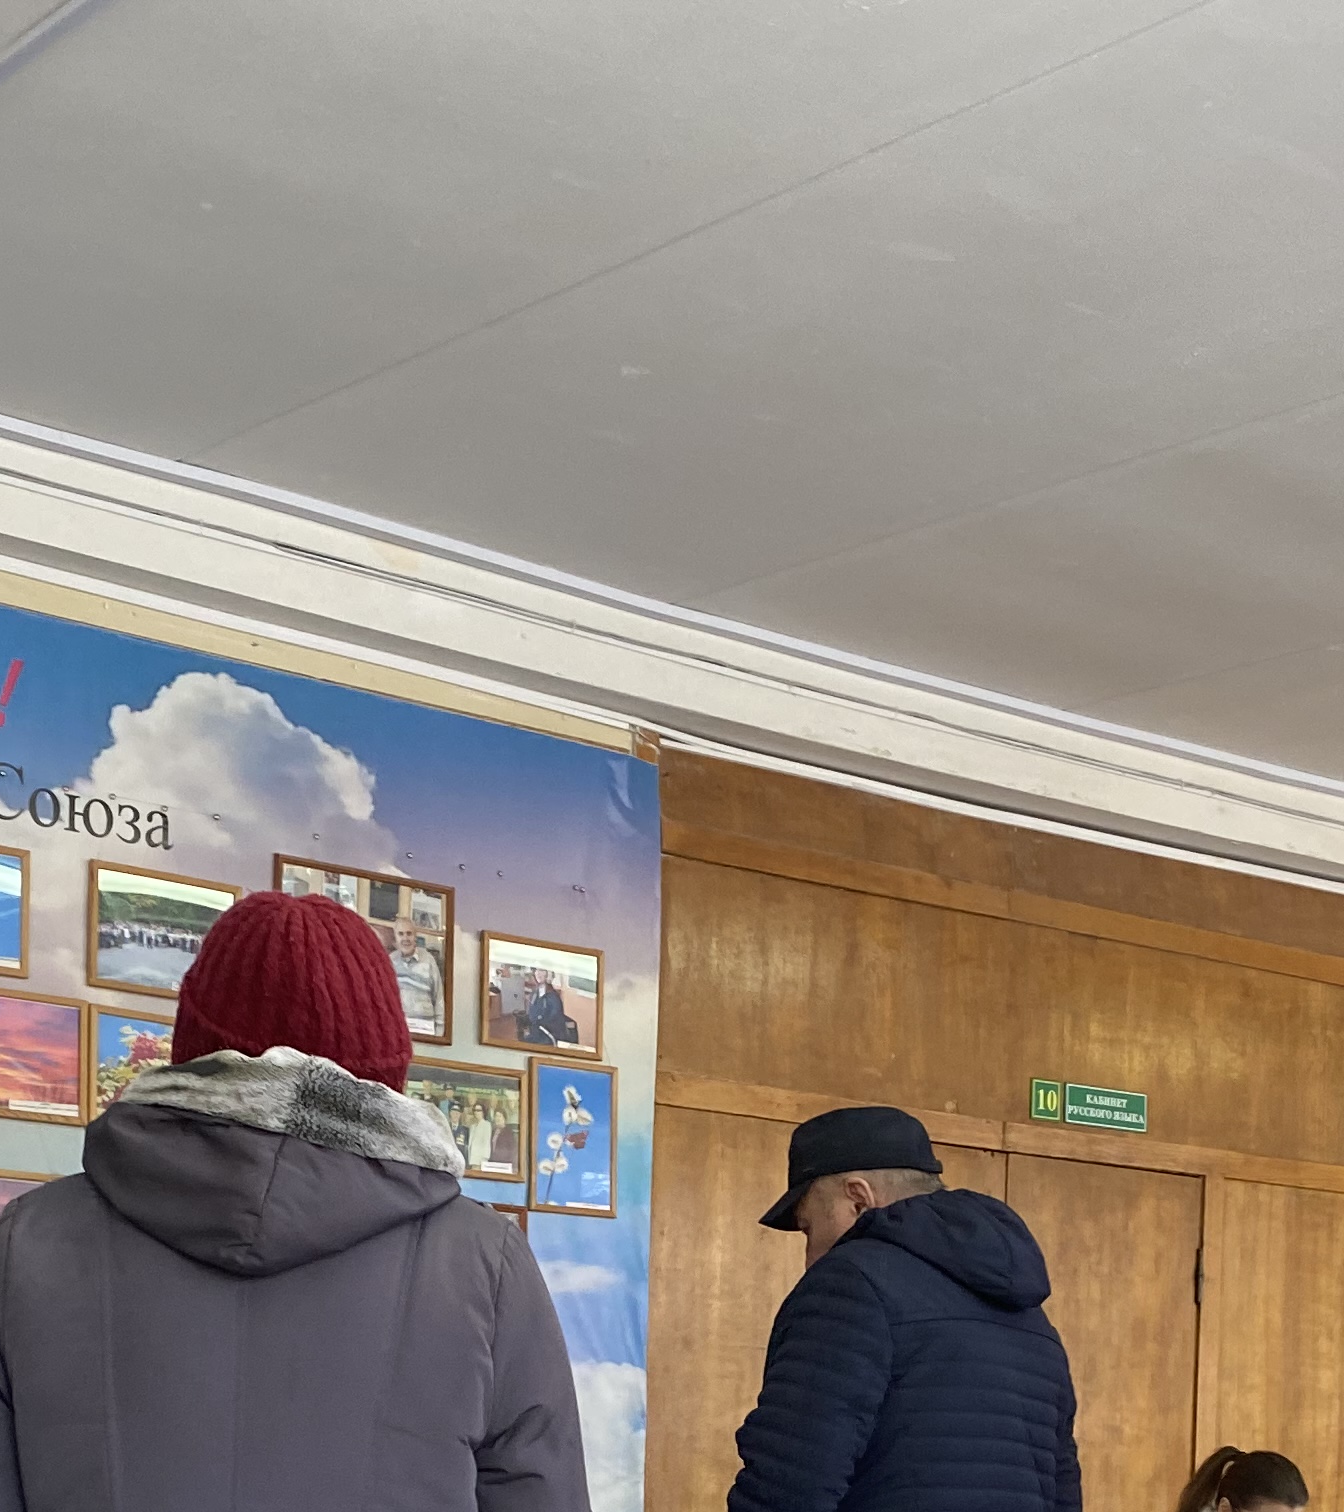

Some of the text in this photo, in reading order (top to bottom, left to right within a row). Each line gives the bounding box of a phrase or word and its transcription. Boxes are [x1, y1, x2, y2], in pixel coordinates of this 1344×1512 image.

[1038, 1089, 1057, 1111] 10
[1086, 1094, 1127, 1108] КАБИНЕТ
[1068, 1105, 1144, 1123] РУССКОГО ЯЗЫКА
